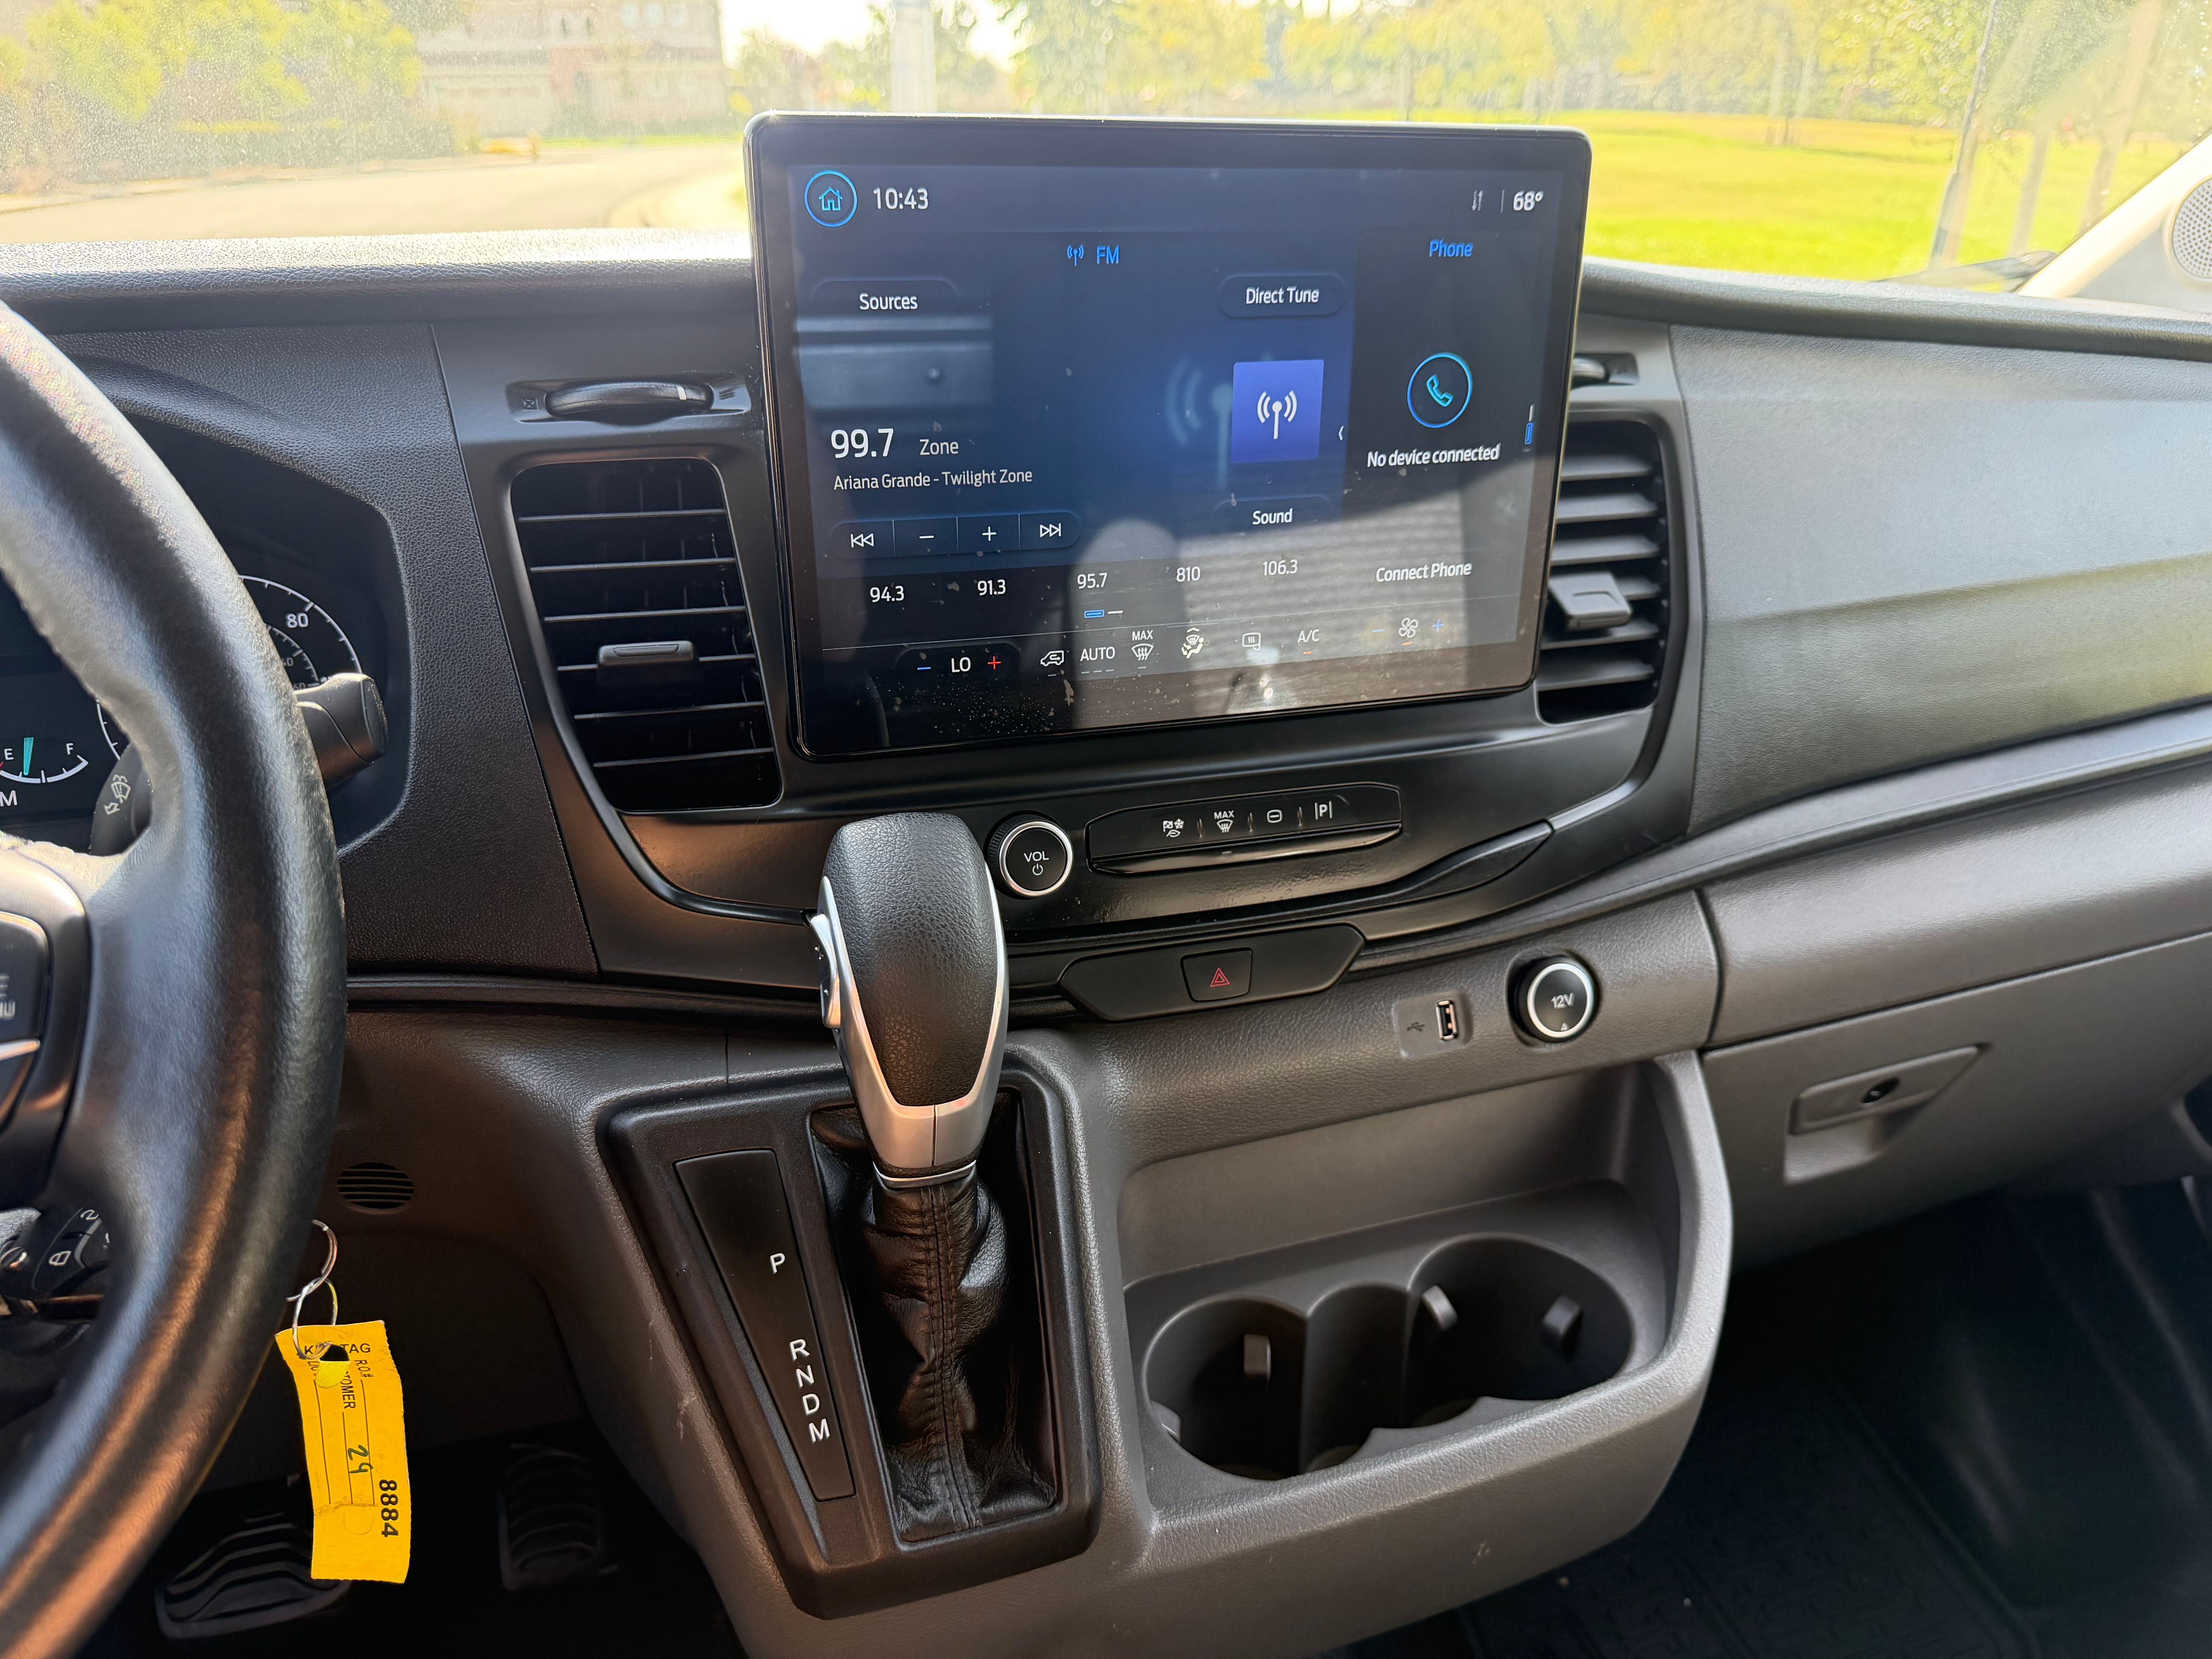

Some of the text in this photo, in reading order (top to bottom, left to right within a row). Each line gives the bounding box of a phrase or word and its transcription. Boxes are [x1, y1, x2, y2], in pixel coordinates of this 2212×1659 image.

[872, 187, 929, 210] 10:43
[1513, 190, 1544, 212] 68°
[1096, 246, 1120, 265] FM
[1429, 239, 1474, 258] Phone
[859, 293, 919, 311] Sources
[1245, 286, 1320, 305] Direct Tune
[831, 428, 959, 459] 99.7 Zone
[1367, 443, 1501, 467] No device connected
[833, 475, 879, 490] Ariana
[881, 472, 931, 489] Grande
[941, 469, 996, 487] Twilight
[1000, 469, 1033, 483] Zone
[1252, 508, 1293, 525] Sound
[870, 559, 1298, 603] 94.3 91.3 95.7 810 106.3
[1376, 562, 1472, 582] Connect Phone
[286, 612, 309, 629] 80
[1132, 629, 1154, 641] MAX
[1297, 629, 1320, 643] A/C
[1080, 646, 1116, 662] AUTO
[951, 657, 971, 673] LO
[4, 748, 14, 761] E
[66, 743, 74, 755] F
[1214, 810, 1235, 819] MAX
[1024, 851, 1049, 862] VOL
[1551, 992, 1575, 1009] 12V
[769, 1252, 785, 1273] P
[790, 1338, 810, 1361] R
[796, 1365, 814, 1388] N
[802, 1393, 820, 1415] D
[809, 1418, 830, 1443] M
[378, 1479, 399, 1538] 8884
